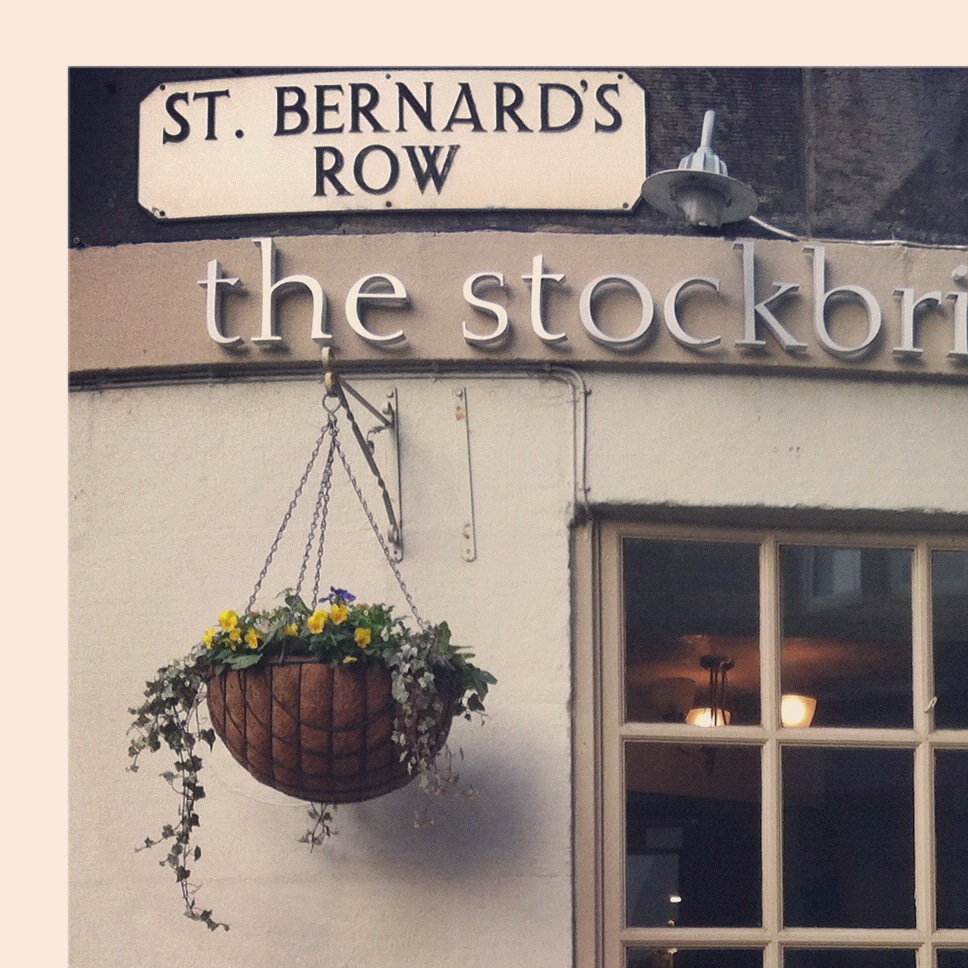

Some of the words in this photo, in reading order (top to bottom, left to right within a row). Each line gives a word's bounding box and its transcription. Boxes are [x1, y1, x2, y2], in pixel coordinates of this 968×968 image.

[162, 90, 243, 144] ST.
[273, 79, 624, 137] BERNARD'S
[313, 144, 460, 198] ROW
[197, 237, 408, 346] the
